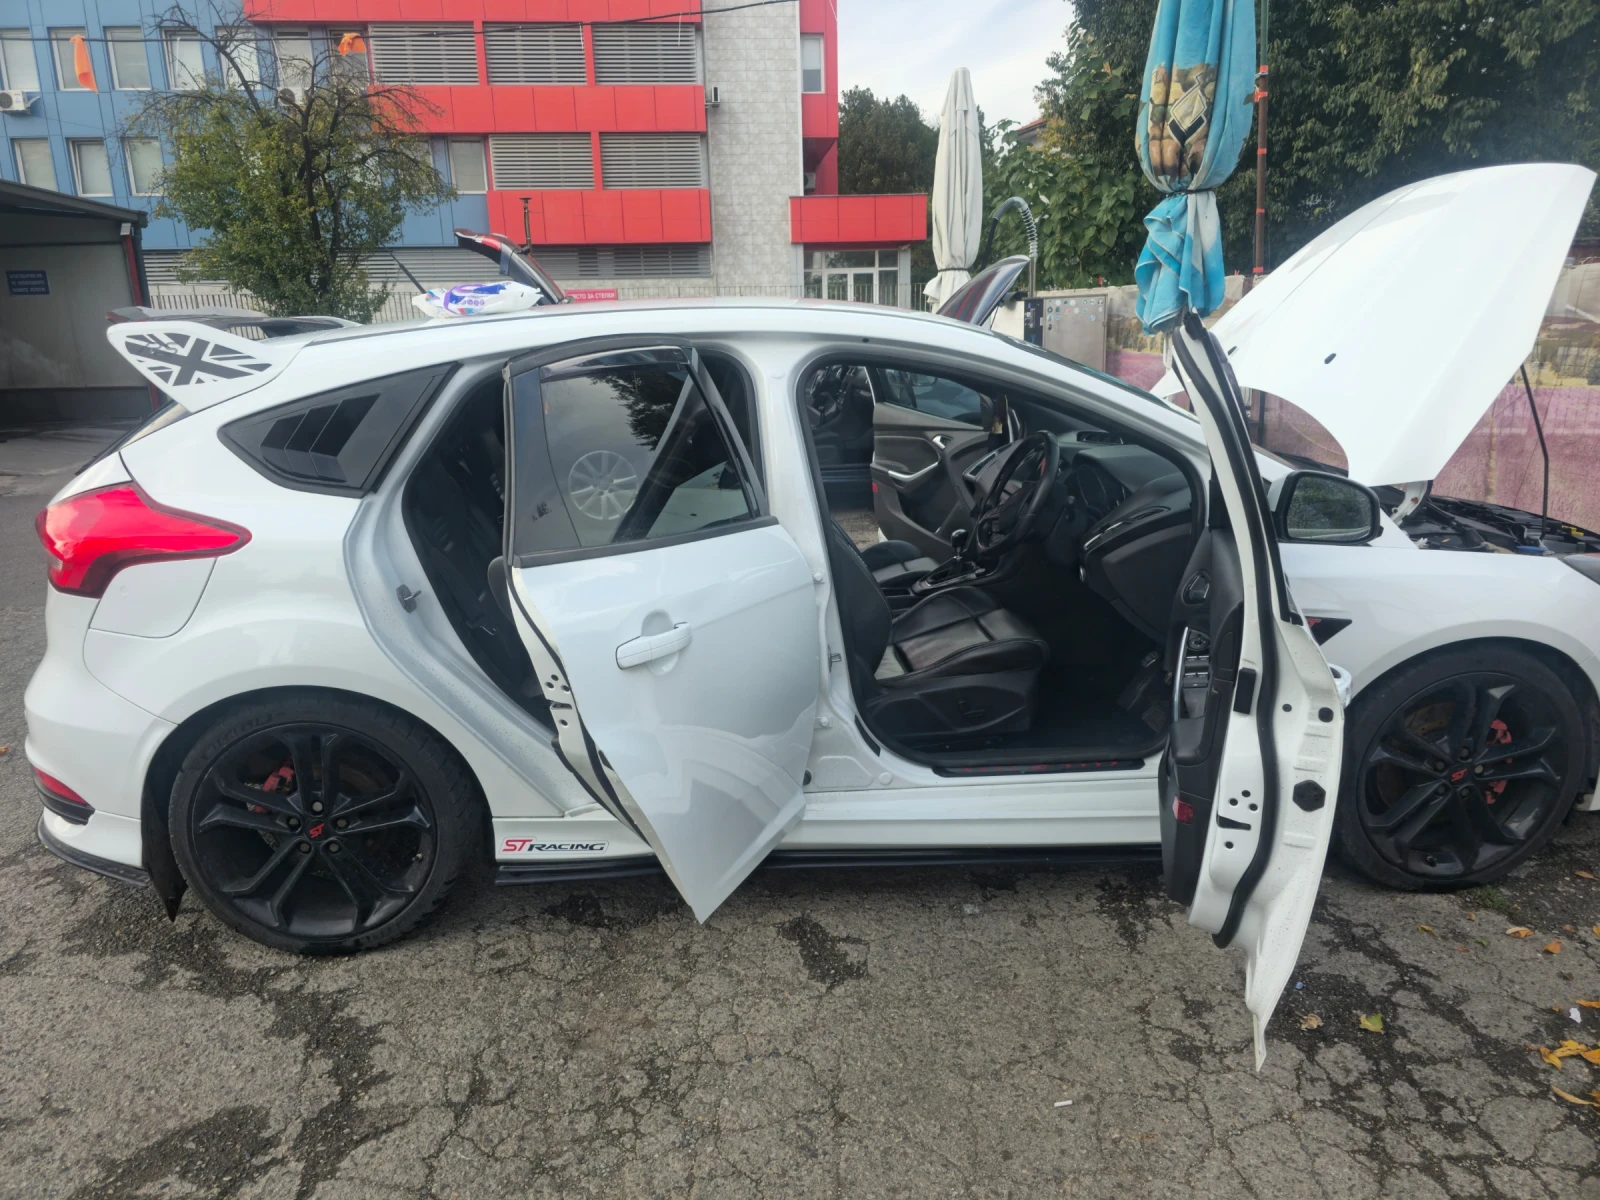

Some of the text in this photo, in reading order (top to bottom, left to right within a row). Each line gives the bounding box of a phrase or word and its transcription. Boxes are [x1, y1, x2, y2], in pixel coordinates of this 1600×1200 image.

[1451, 768, 1468, 781] ST
[309, 823, 324, 838] ST
[502, 839, 606, 852] ST RACING
